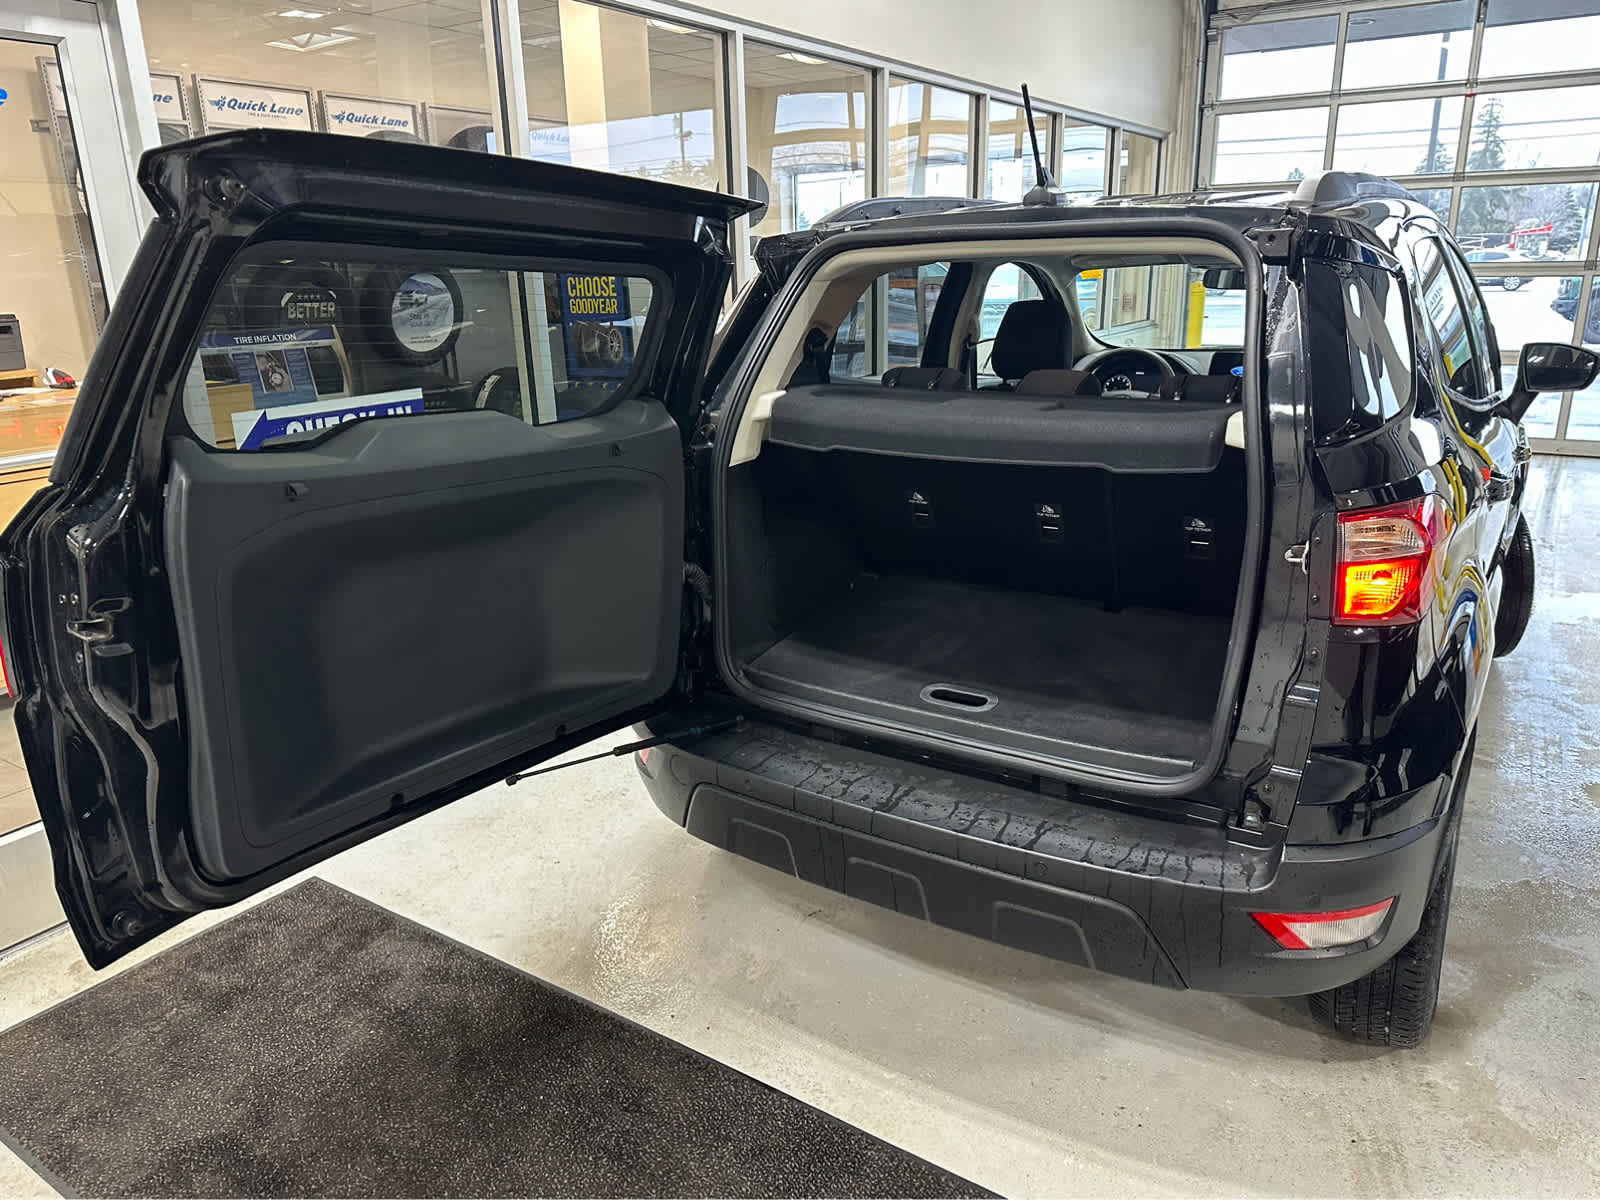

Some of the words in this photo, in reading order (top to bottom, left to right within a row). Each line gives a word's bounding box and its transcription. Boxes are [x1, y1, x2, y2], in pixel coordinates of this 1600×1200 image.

[226, 98, 268, 112] Quick
[269, 103, 304, 116] Lane
[346, 112, 379, 125] Quick
[380, 116, 409, 128] Lane
[567, 276, 617, 297] CHOOSE
[287, 302, 336, 319] BETTER
[569, 298, 618, 314] GOODYEAR
[233, 335, 254, 344] TIRE
[254, 333, 297, 343] INFLATION
